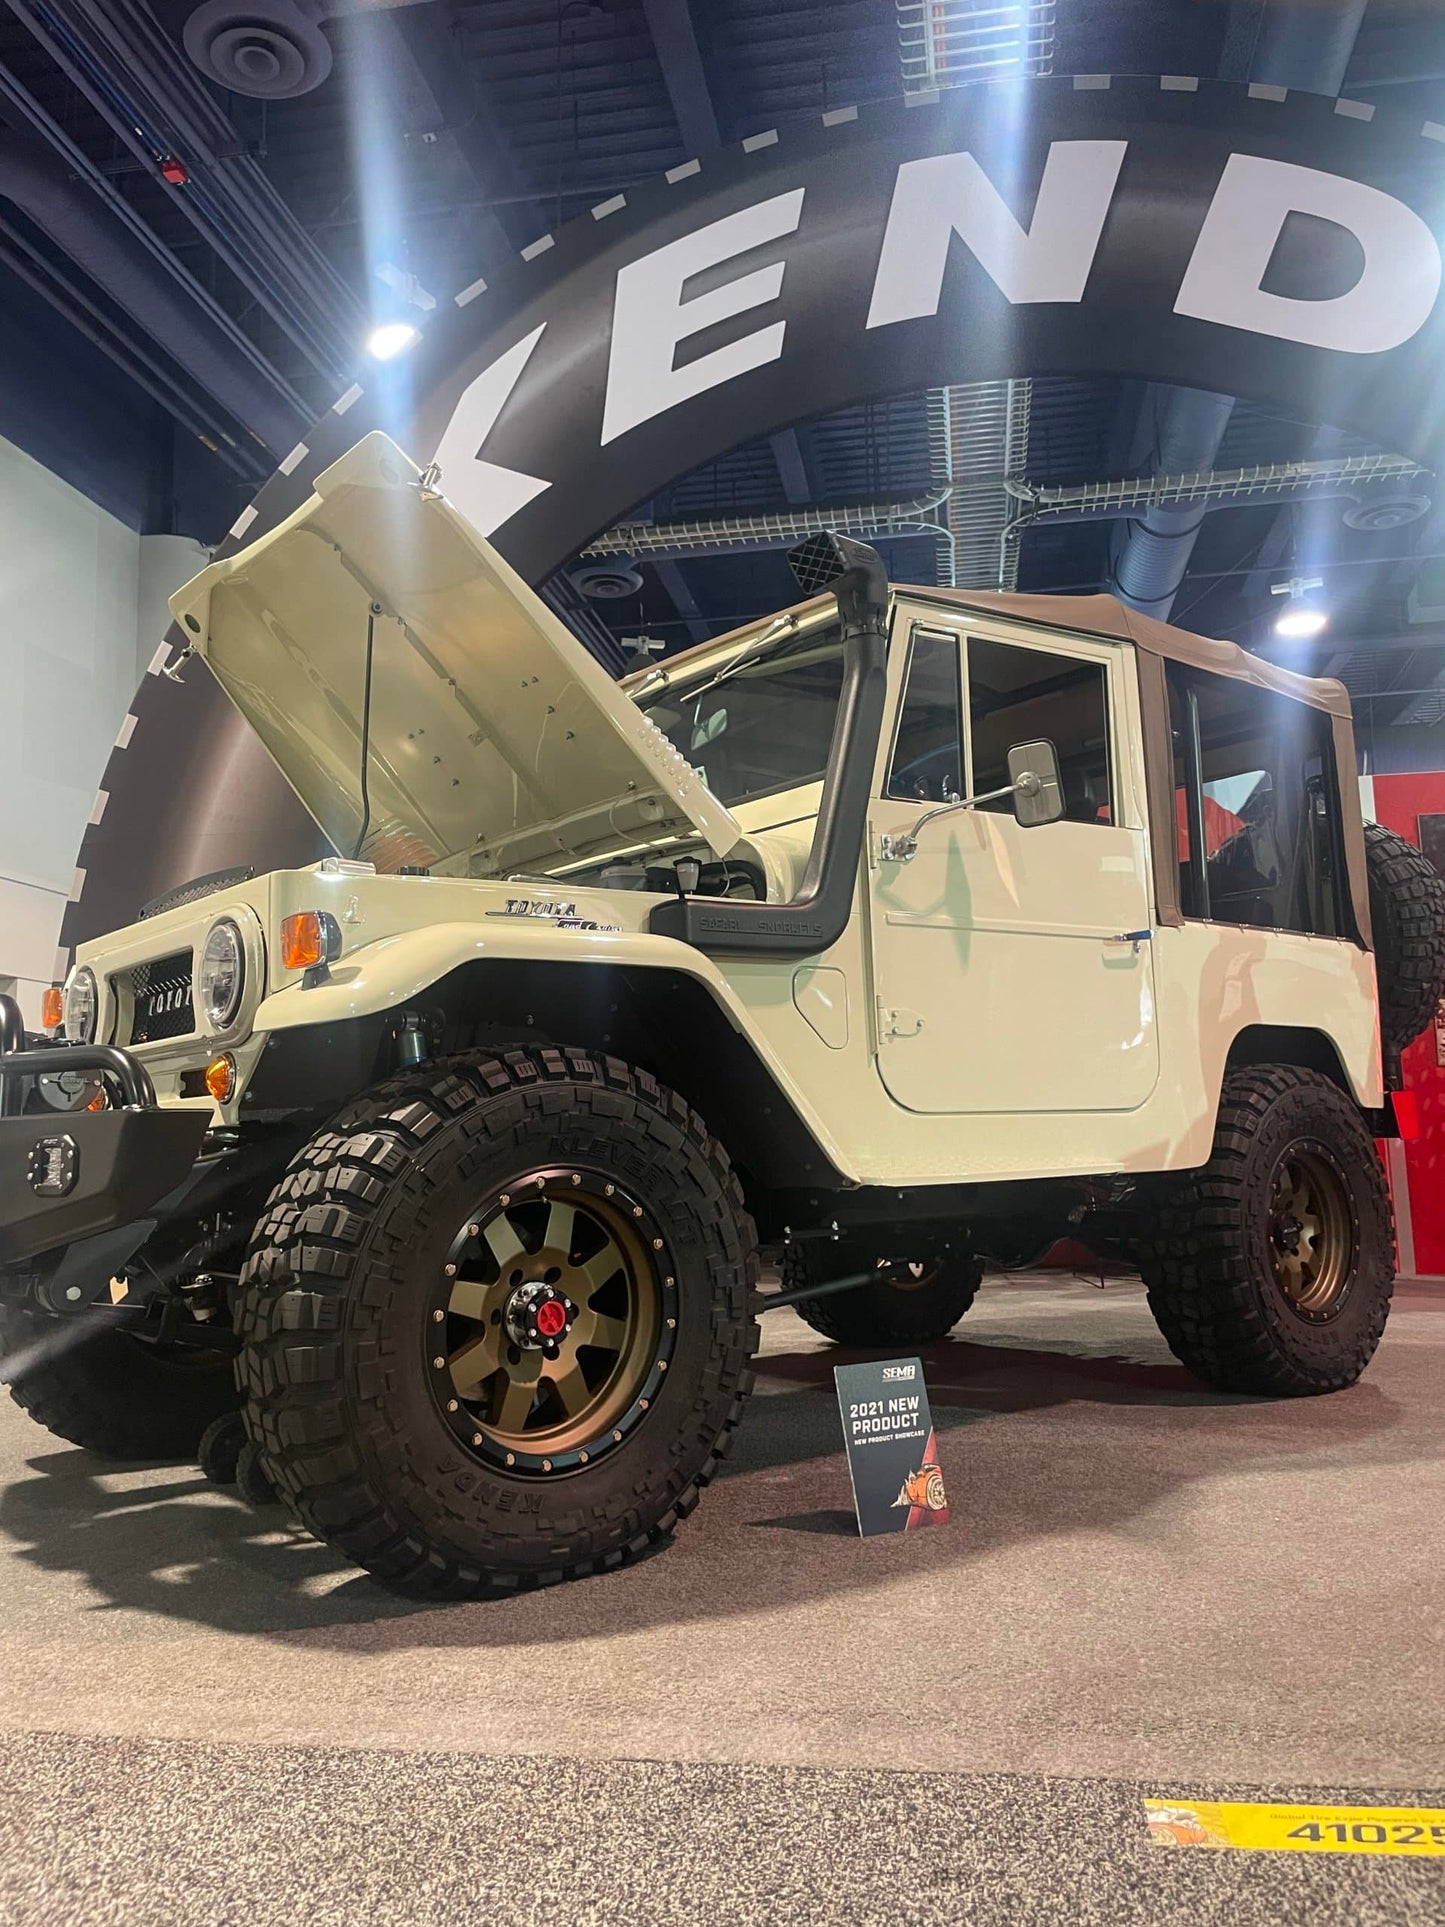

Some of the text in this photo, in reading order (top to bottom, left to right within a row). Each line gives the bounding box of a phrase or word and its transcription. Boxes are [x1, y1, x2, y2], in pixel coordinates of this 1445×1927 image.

[505, 899, 577, 917] TOYOTA
[699, 916, 823, 936] SAFARI SNORKELS
[882, 1365, 916, 1379] SEMA
[849, 1396, 919, 1418] 2021 NEW
[852, 1413, 919, 1435] PRODUCT
[854, 1430, 925, 1446] NEW PRODUCT SHOWCASE
[437, 1454, 545, 1514] KENDA
